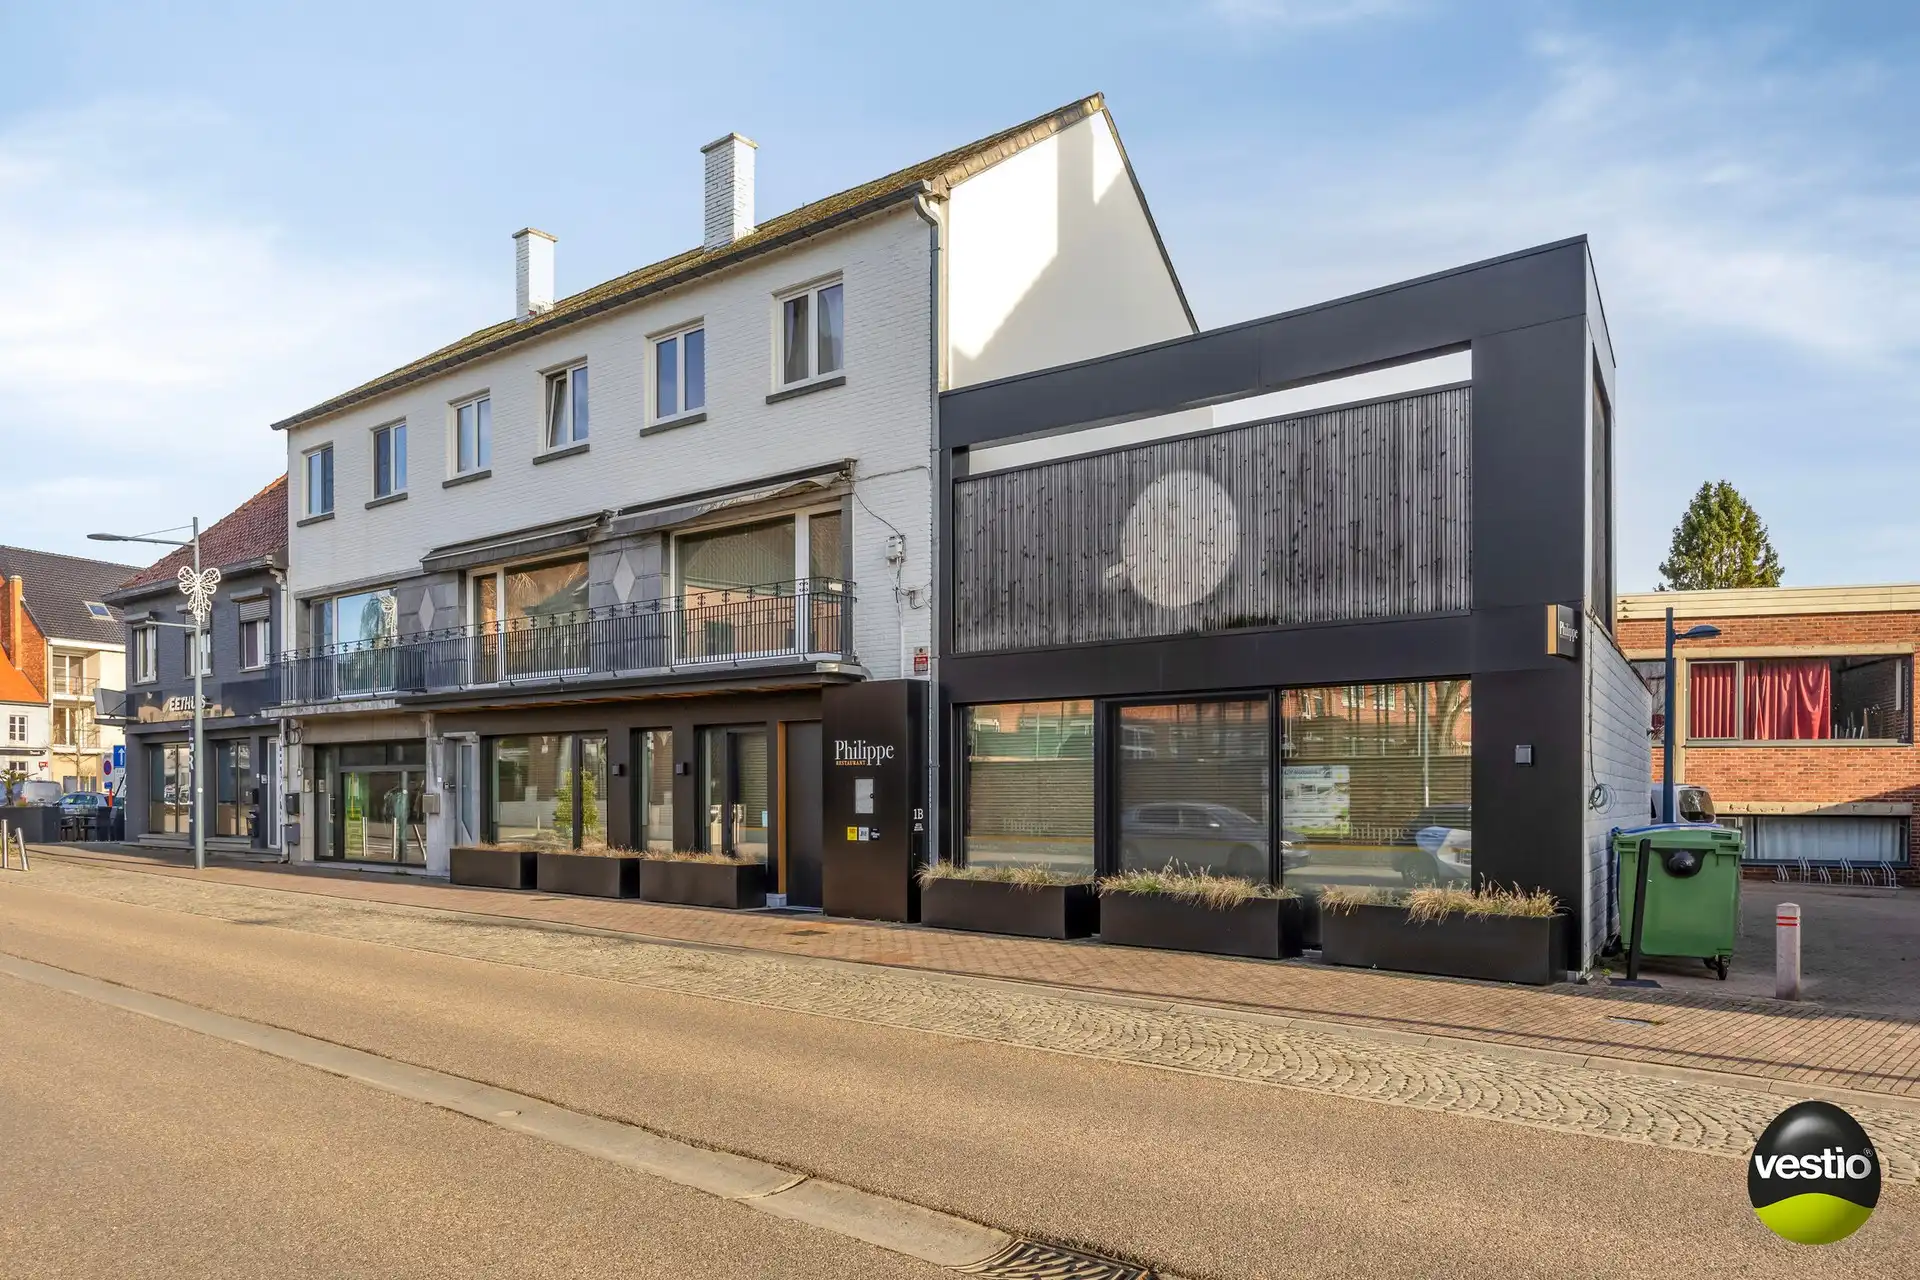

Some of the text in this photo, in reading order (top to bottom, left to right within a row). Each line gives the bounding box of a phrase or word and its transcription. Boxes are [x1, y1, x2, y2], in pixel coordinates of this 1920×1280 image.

[169, 694, 206, 712] EETHUS
[834, 739, 895, 766] Philippe
[913, 808, 924, 820] 1B
